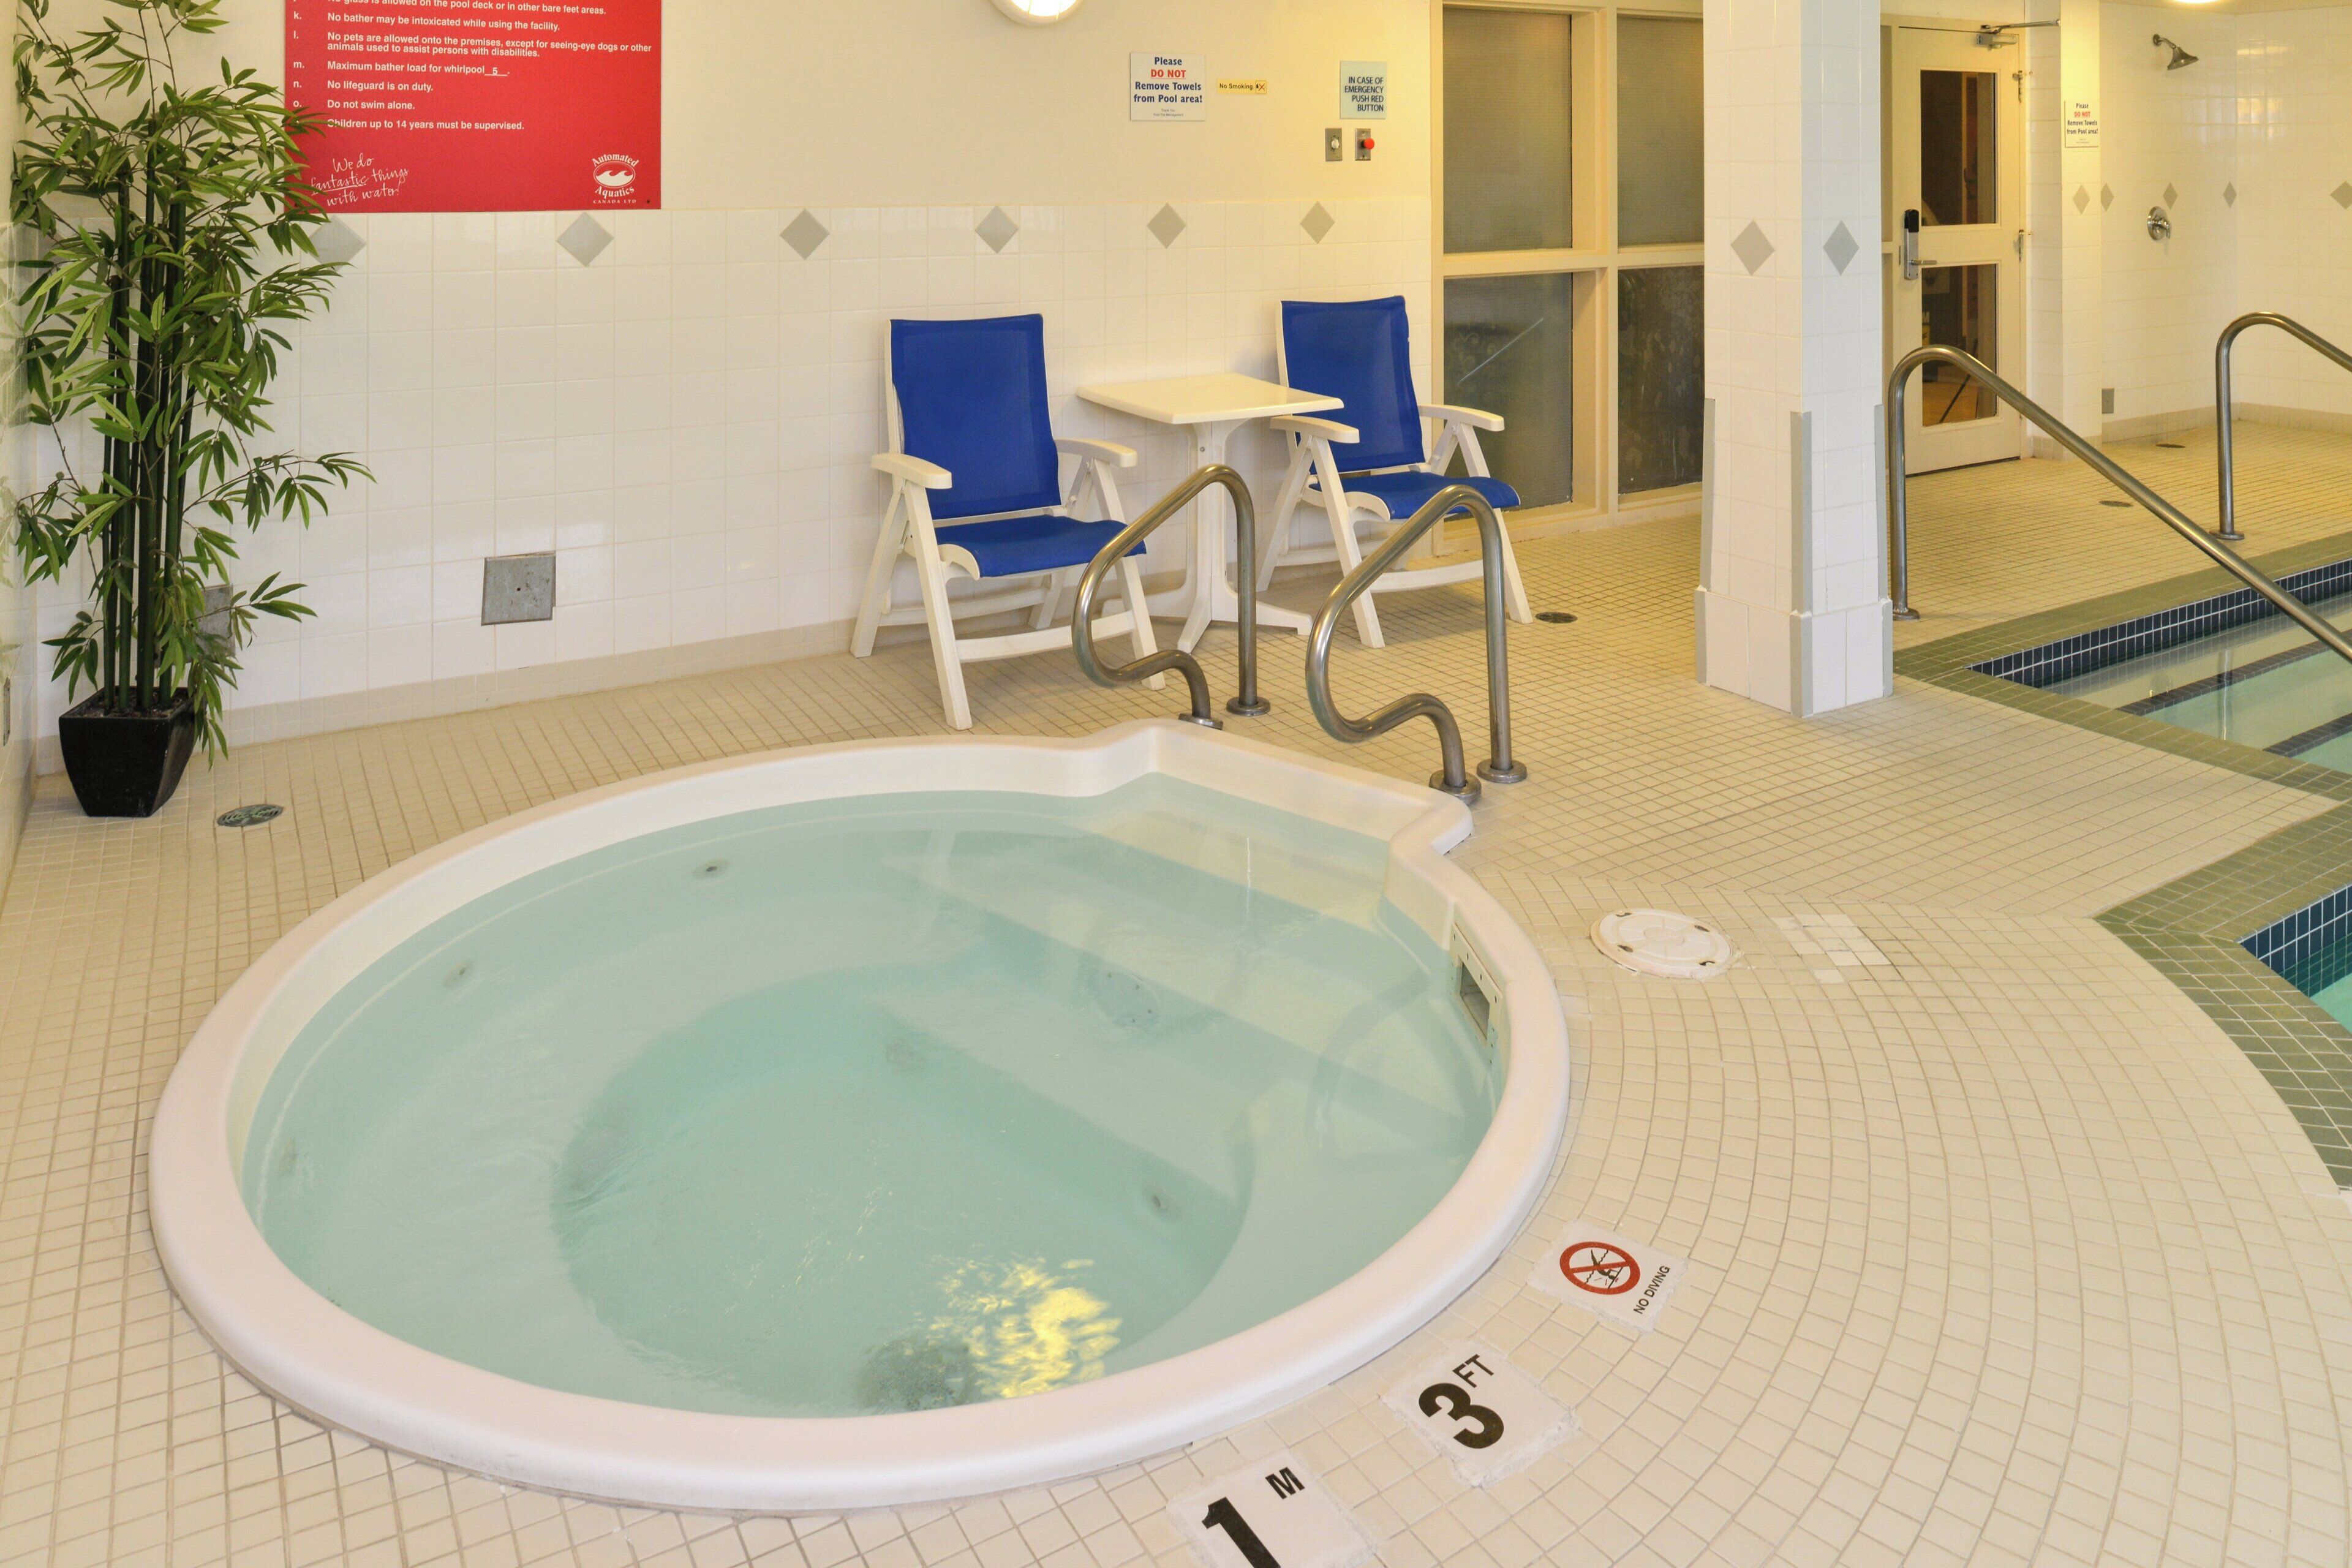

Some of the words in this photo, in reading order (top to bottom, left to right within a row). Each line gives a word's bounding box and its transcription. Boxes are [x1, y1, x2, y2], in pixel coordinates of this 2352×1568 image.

[450, 0, 470, 10] pool
[472, 0, 493, 9] deck
[508, 1, 515, 10] in
[518, 2, 540, 12] other
[542, 3, 561, 13] bare
[564, 4, 579, 13] feet
[294, 11, 301, 20] k.
[328, 13, 341, 22] No
[344, 13, 374, 23] bather
[377, 16, 395, 26] may
[398, 15, 409, 24] be
[412, 15, 461, 26] intoxicated
[463, 17, 486, 27] while
[489, 18, 512, 30] using
[514, 20, 528, 29] the
[530, 20, 559, 32] facility.
[328, 32, 341, 41] No
[344, 32, 364, 43] pets
[384, 34, 419, 44] allowed
[421, 36, 442, 45] onto
[444, 36, 458, 45] the
[461, 37, 503, 49] premises,
[506, 39, 534, 50] except
[536, 39, 548, 48] for
[551, 40, 595, 52] seeing-eye
[598, 42, 618, 53] dogs
[631, 42, 651, 51] other
[328, 42, 364, 51] animals
[367, 43, 389, 52] used
[391, 43, 401, 53] to
[403, 44, 430, 54] assist
[432, 47, 468, 57] persons
[471, 47, 489, 56] with
[491, 47, 540, 56] disabilities.
[328, 61, 372, 71] Maximum
[375, 62, 404, 72] bather
[407, 63, 426, 72] load
[429, 64, 442, 73] for
[444, 64, 484, 76] whirlpool
[328, 80, 341, 89] No
[344, 81, 384, 92] lifeguard
[387, 82, 395, 91] is
[412, 83, 433, 94] duty.
[1135, 81, 1169, 90] Remove
[328, 100, 341, 108] Do
[344, 100, 358, 109] not
[361, 100, 385, 109] swim
[388, 100, 415, 110] alone.
[1158, 94, 1177, 103] Pool
[327, 119, 367, 128] Children
[370, 121, 381, 130] up
[384, 119, 393, 128] to
[396, 119, 407, 129] 14
[409, 122, 434, 130] years
[437, 120, 458, 129] must
[461, 121, 472, 130] be
[475, 121, 524, 133] supervised.
[333, 158, 353, 173] We
[356, 153, 374, 168] do
[592, 154, 639, 167] Automated
[311, 171, 369, 196] fantastic
[371, 168, 409, 183] things
[327, 189, 358, 206] with
[595, 186, 635, 199] Aquatics
[1634, 1298, 1649, 1314] NO
[1644, 1265, 1670, 1297] DIVING
[1452, 1354, 1494, 1388] FT
[1419, 1382, 1504, 1449] 3
[1202, 1496, 1281, 1568] 1
[1265, 1466, 1305, 1499] M
